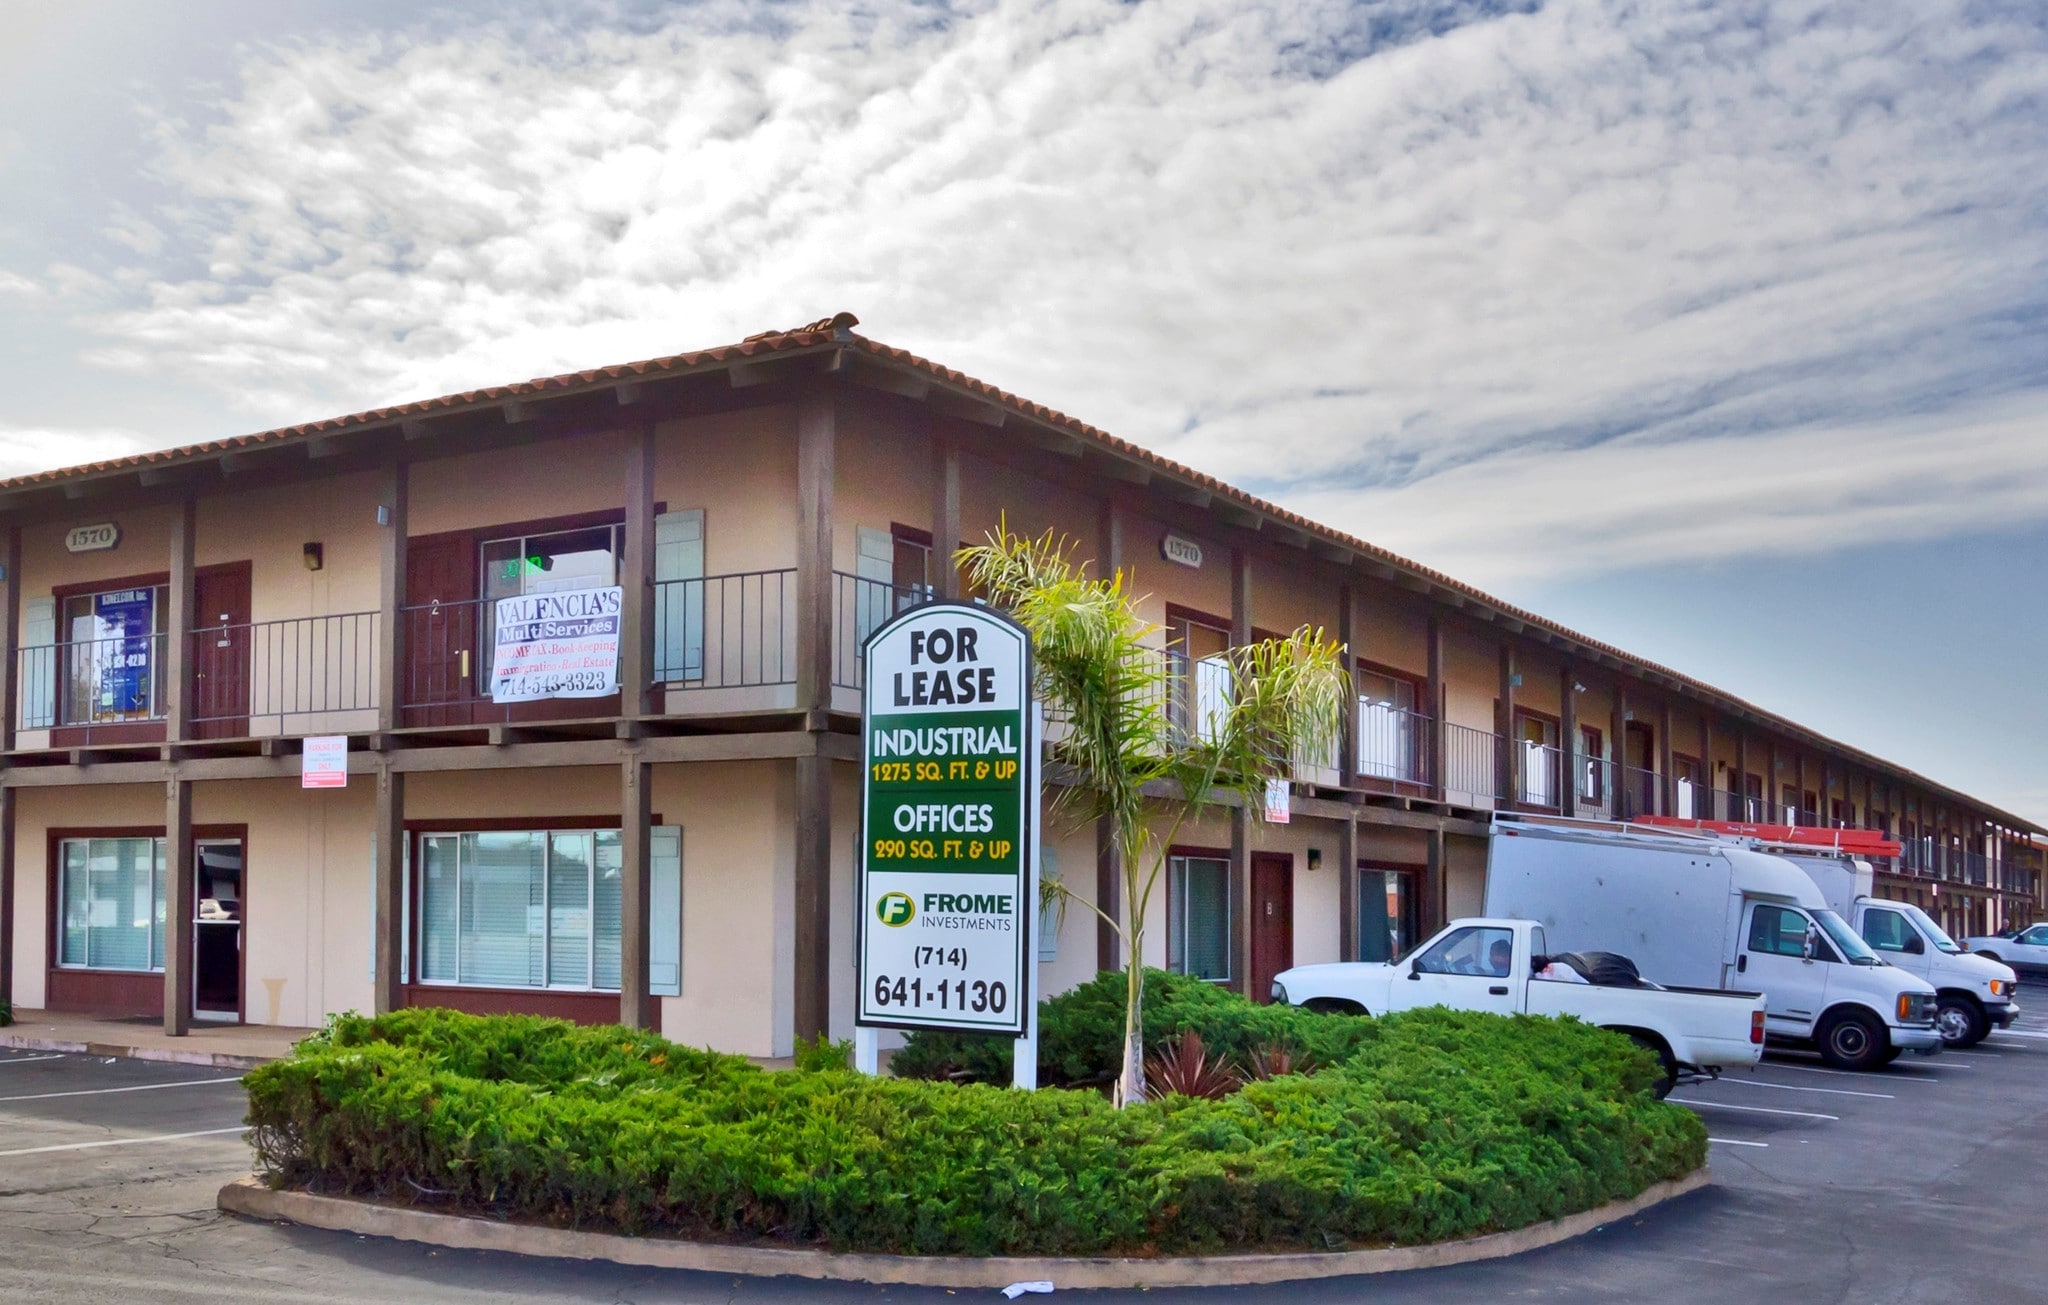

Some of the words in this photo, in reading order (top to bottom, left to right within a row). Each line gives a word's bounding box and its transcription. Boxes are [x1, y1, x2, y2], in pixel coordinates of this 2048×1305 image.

[72, 528, 112, 546] 1570
[1169, 540, 1199, 562] 1570
[431, 599, 440, 616] 2
[498, 591, 620, 625] VALENCIA'S
[501, 624, 543, 642] Multi
[545, 620, 613, 637] Services
[910, 627, 978, 665] FOR
[583, 656, 615, 668] Estate
[501, 671, 606, 696] 714-543-3323
[893, 667, 996, 707] LEASE
[874, 725, 1017, 757] INDUSTRIAL
[872, 762, 911, 782] 1275
[915, 762, 944, 781] SQ.
[949, 761, 969, 780] FT.
[974, 761, 990, 780] &
[995, 760, 1017, 779] UP
[893, 803, 993, 833] OFFICES
[875, 840, 906, 859] 290
[909, 840, 937, 859] SQ.
[943, 840, 963, 859] FT.
[969, 840, 984, 859] &
[989, 840, 1011, 859] UP
[923, 893, 1012, 915] FROME
[921, 915, 1011, 931] INVESTMENTS
[914, 946, 968, 971] (714)
[875, 974, 1006, 1014] 641-1130
